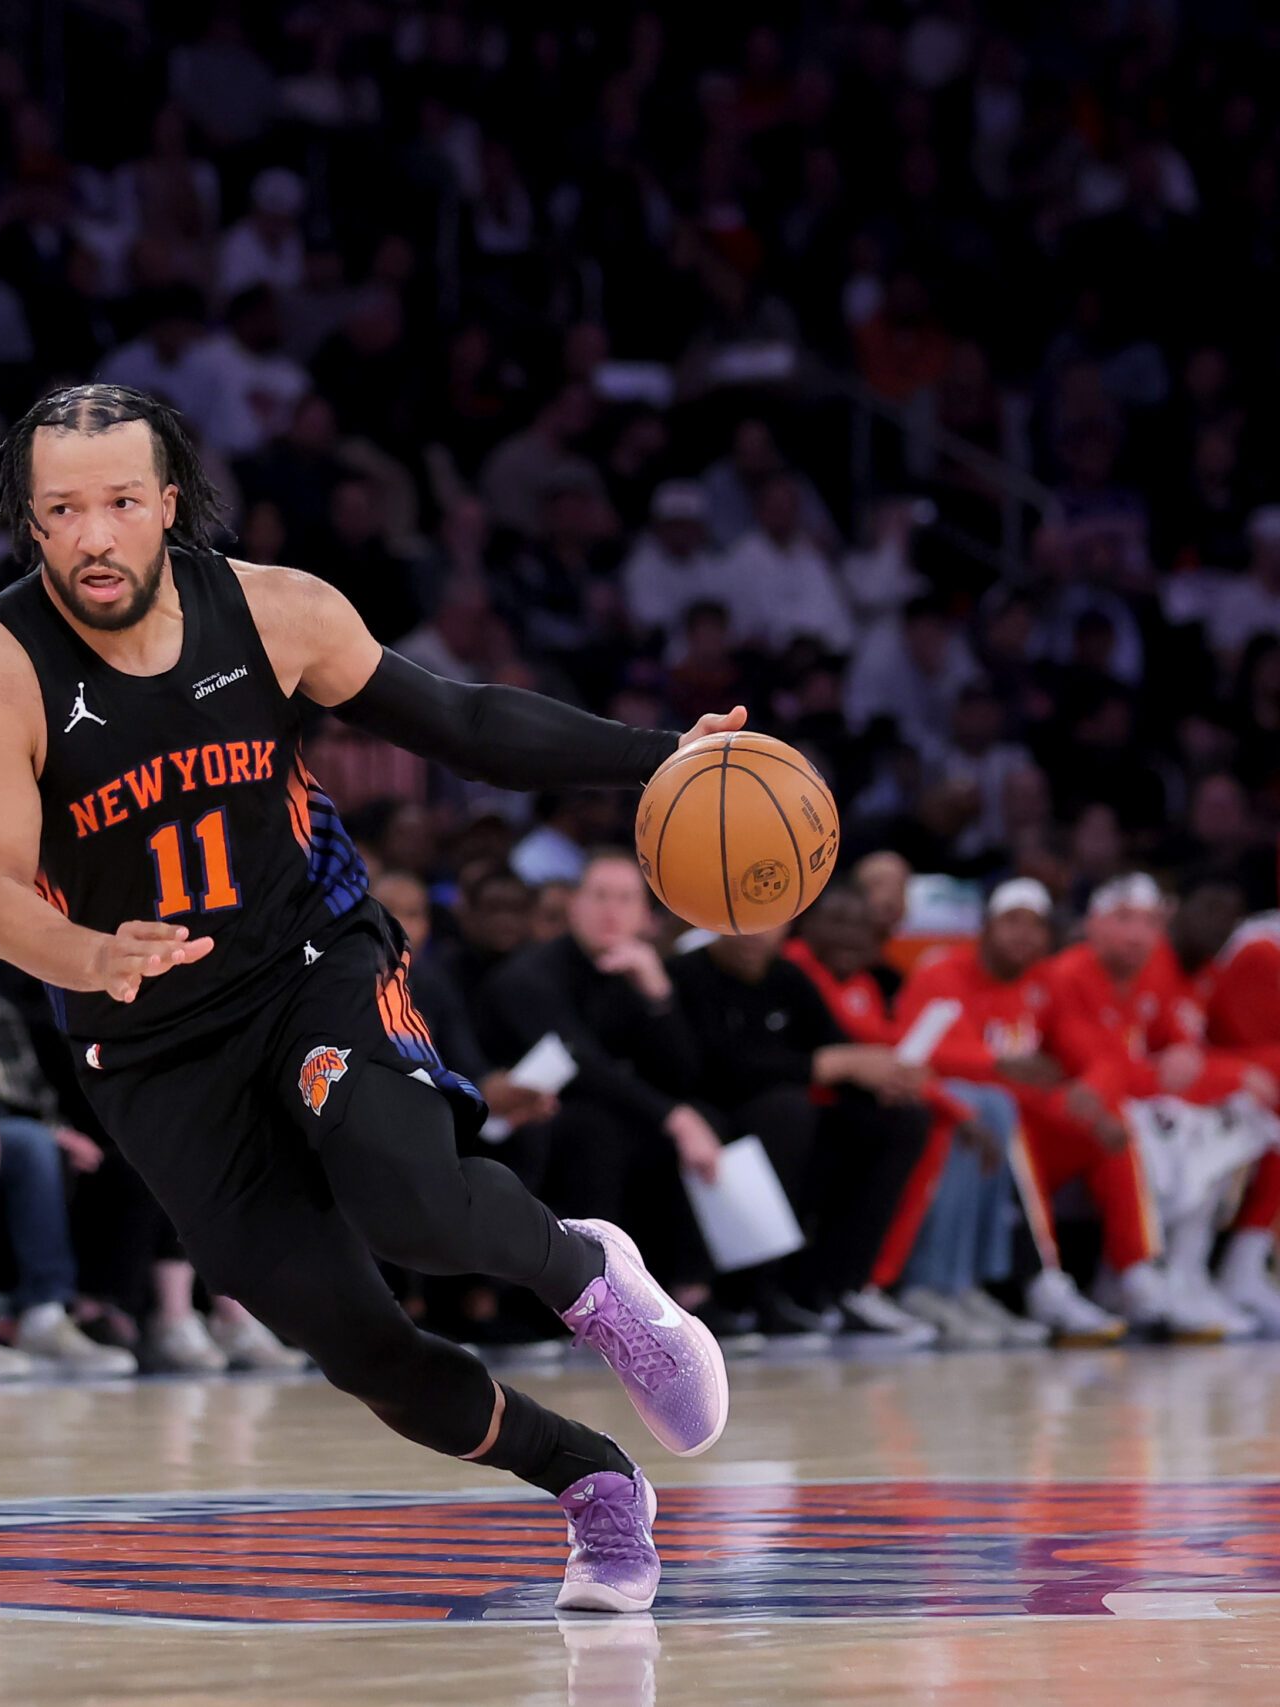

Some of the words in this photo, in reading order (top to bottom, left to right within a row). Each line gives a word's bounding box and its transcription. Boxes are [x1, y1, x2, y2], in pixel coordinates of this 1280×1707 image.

[195, 683, 216, 700] abu
[216, 665, 248, 688] dhabi
[69, 756, 164, 839] NEW
[169, 740, 277, 792] YORK
[146, 805, 244, 921] 11
